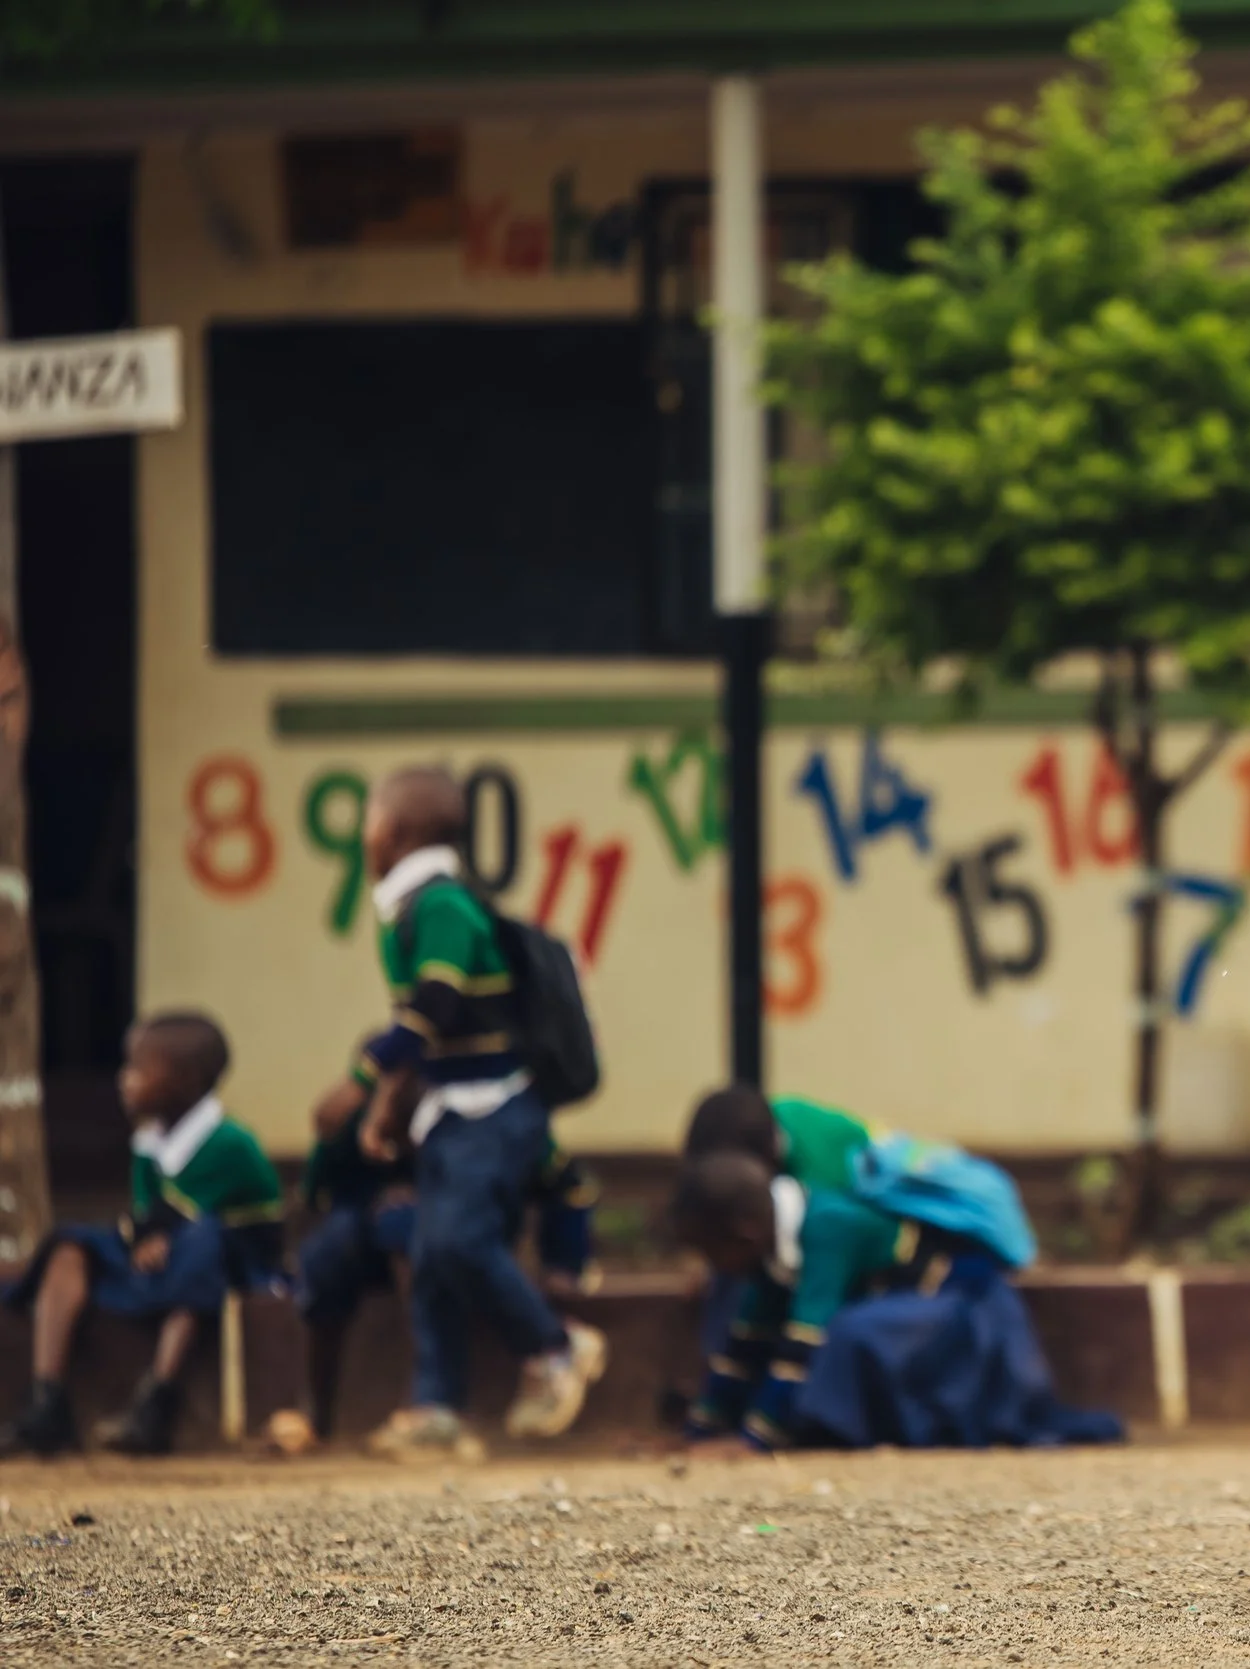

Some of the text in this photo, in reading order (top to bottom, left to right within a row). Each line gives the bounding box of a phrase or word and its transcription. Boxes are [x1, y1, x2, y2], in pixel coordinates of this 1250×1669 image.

[185, 753, 279, 903] 8
[303, 765, 370, 936] 9
[938, 834, 1049, 1002] 15
